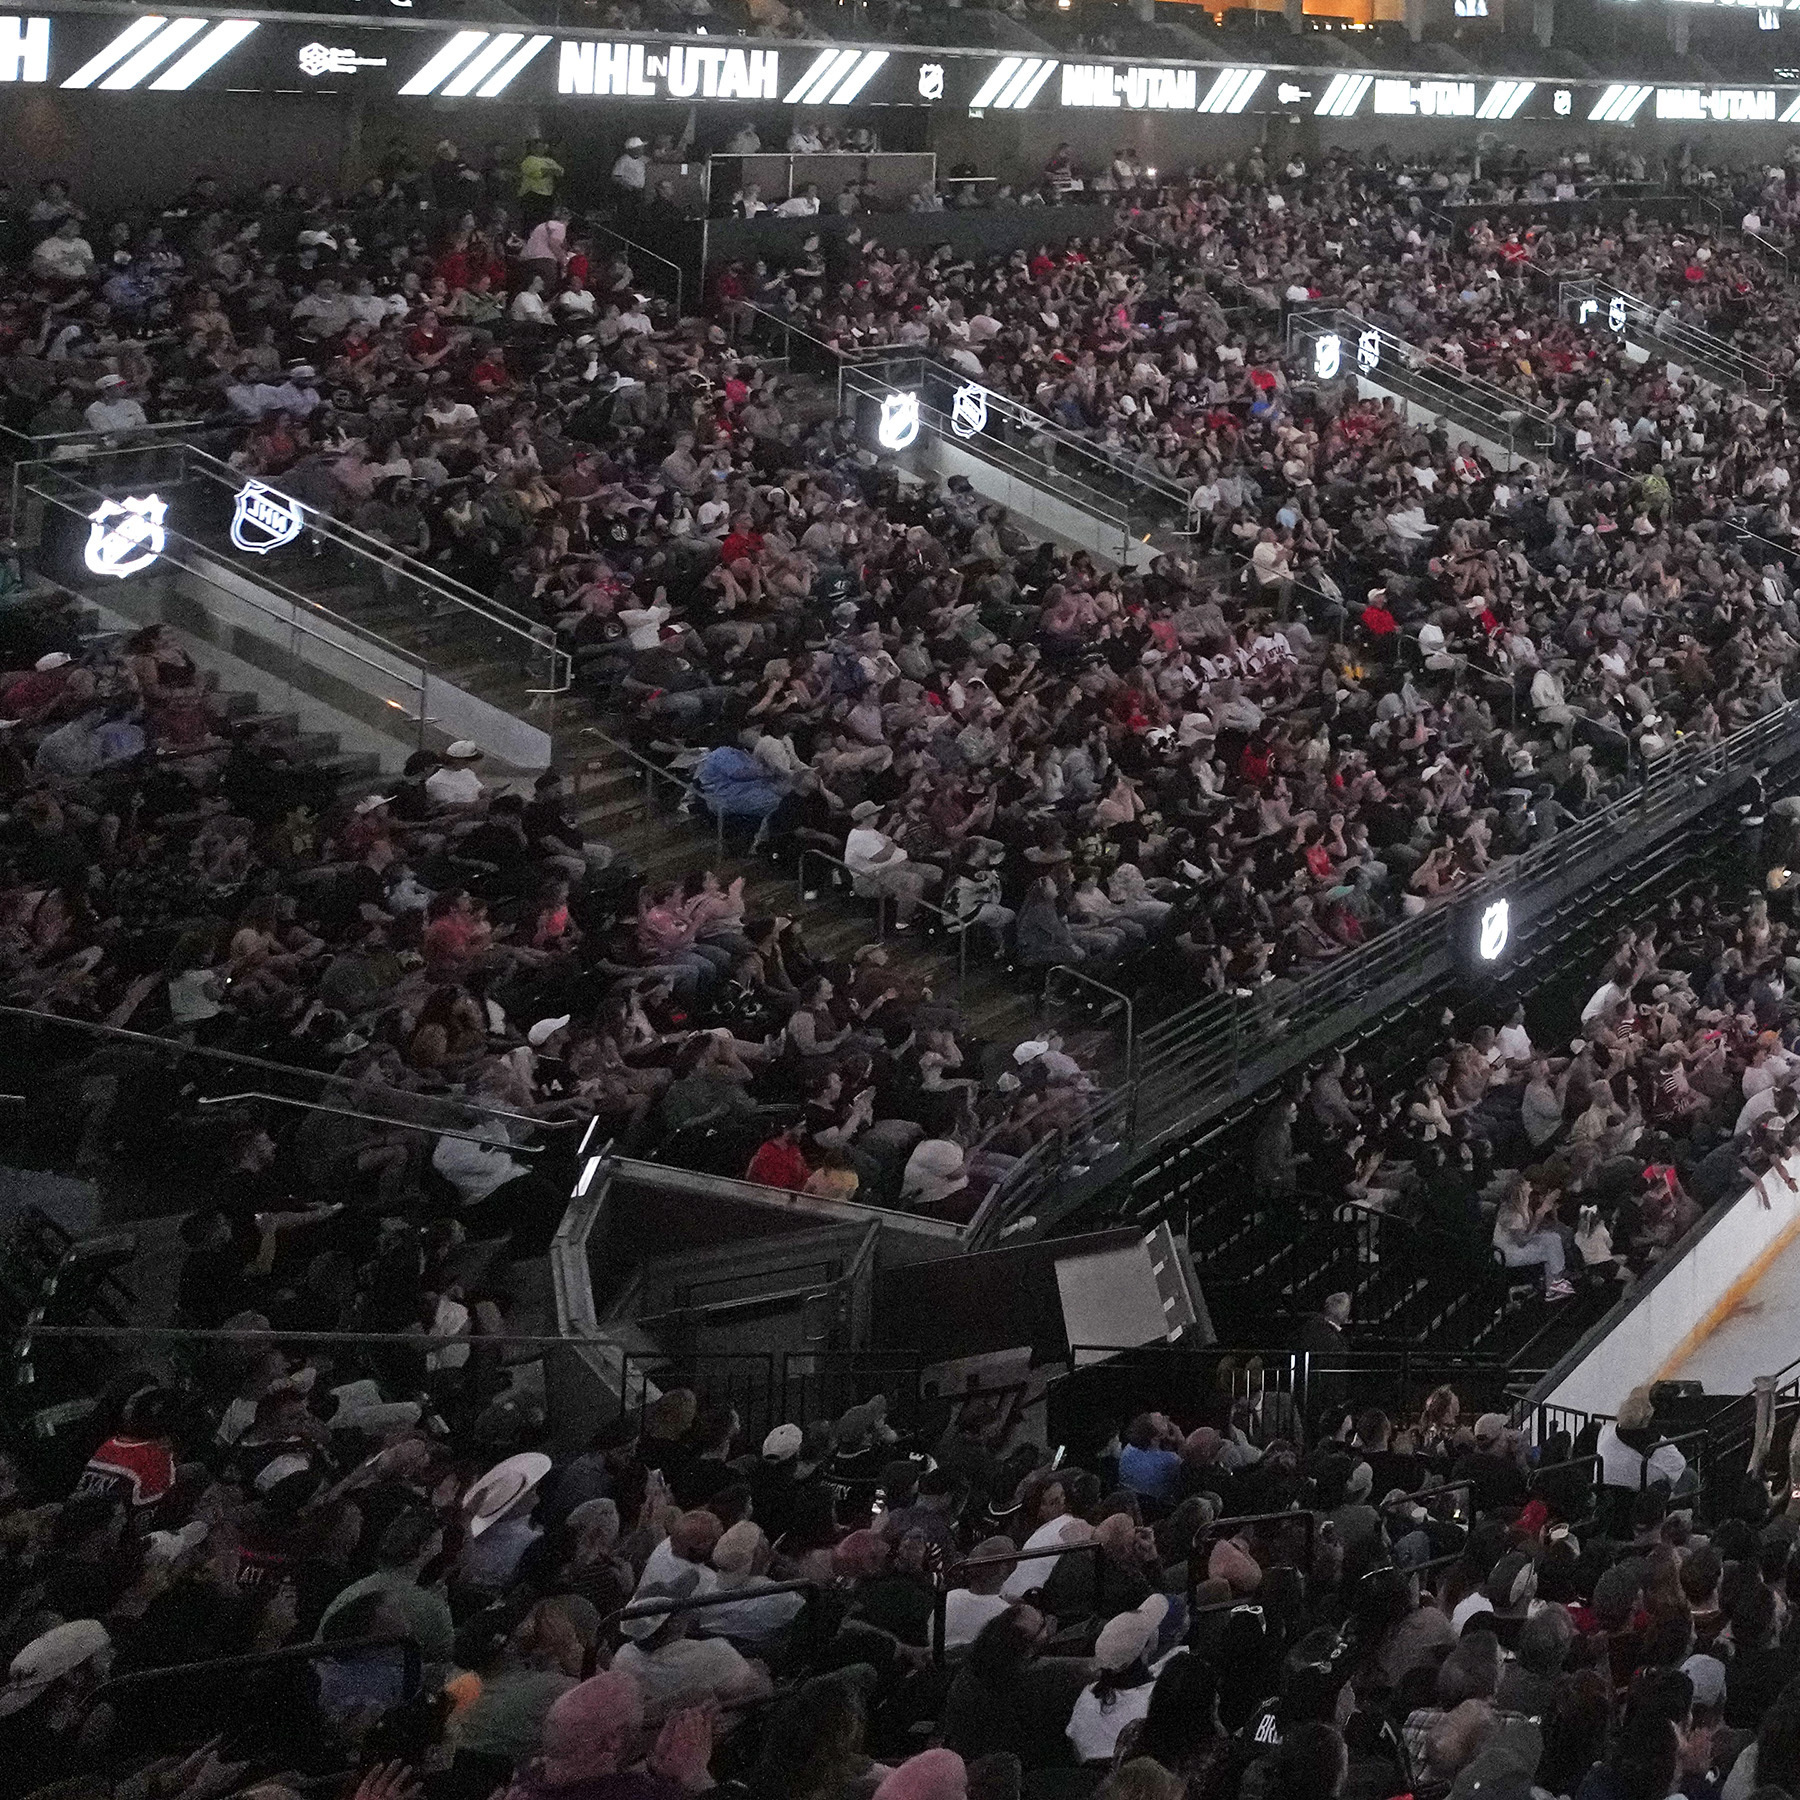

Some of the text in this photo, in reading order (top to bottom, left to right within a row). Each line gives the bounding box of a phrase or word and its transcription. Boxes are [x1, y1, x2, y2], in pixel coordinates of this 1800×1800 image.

[559, 41, 778, 99] NHL IN UTAH
[1127, 67, 1196, 109] UTAH
[1711, 90, 1775, 120] UTAH
